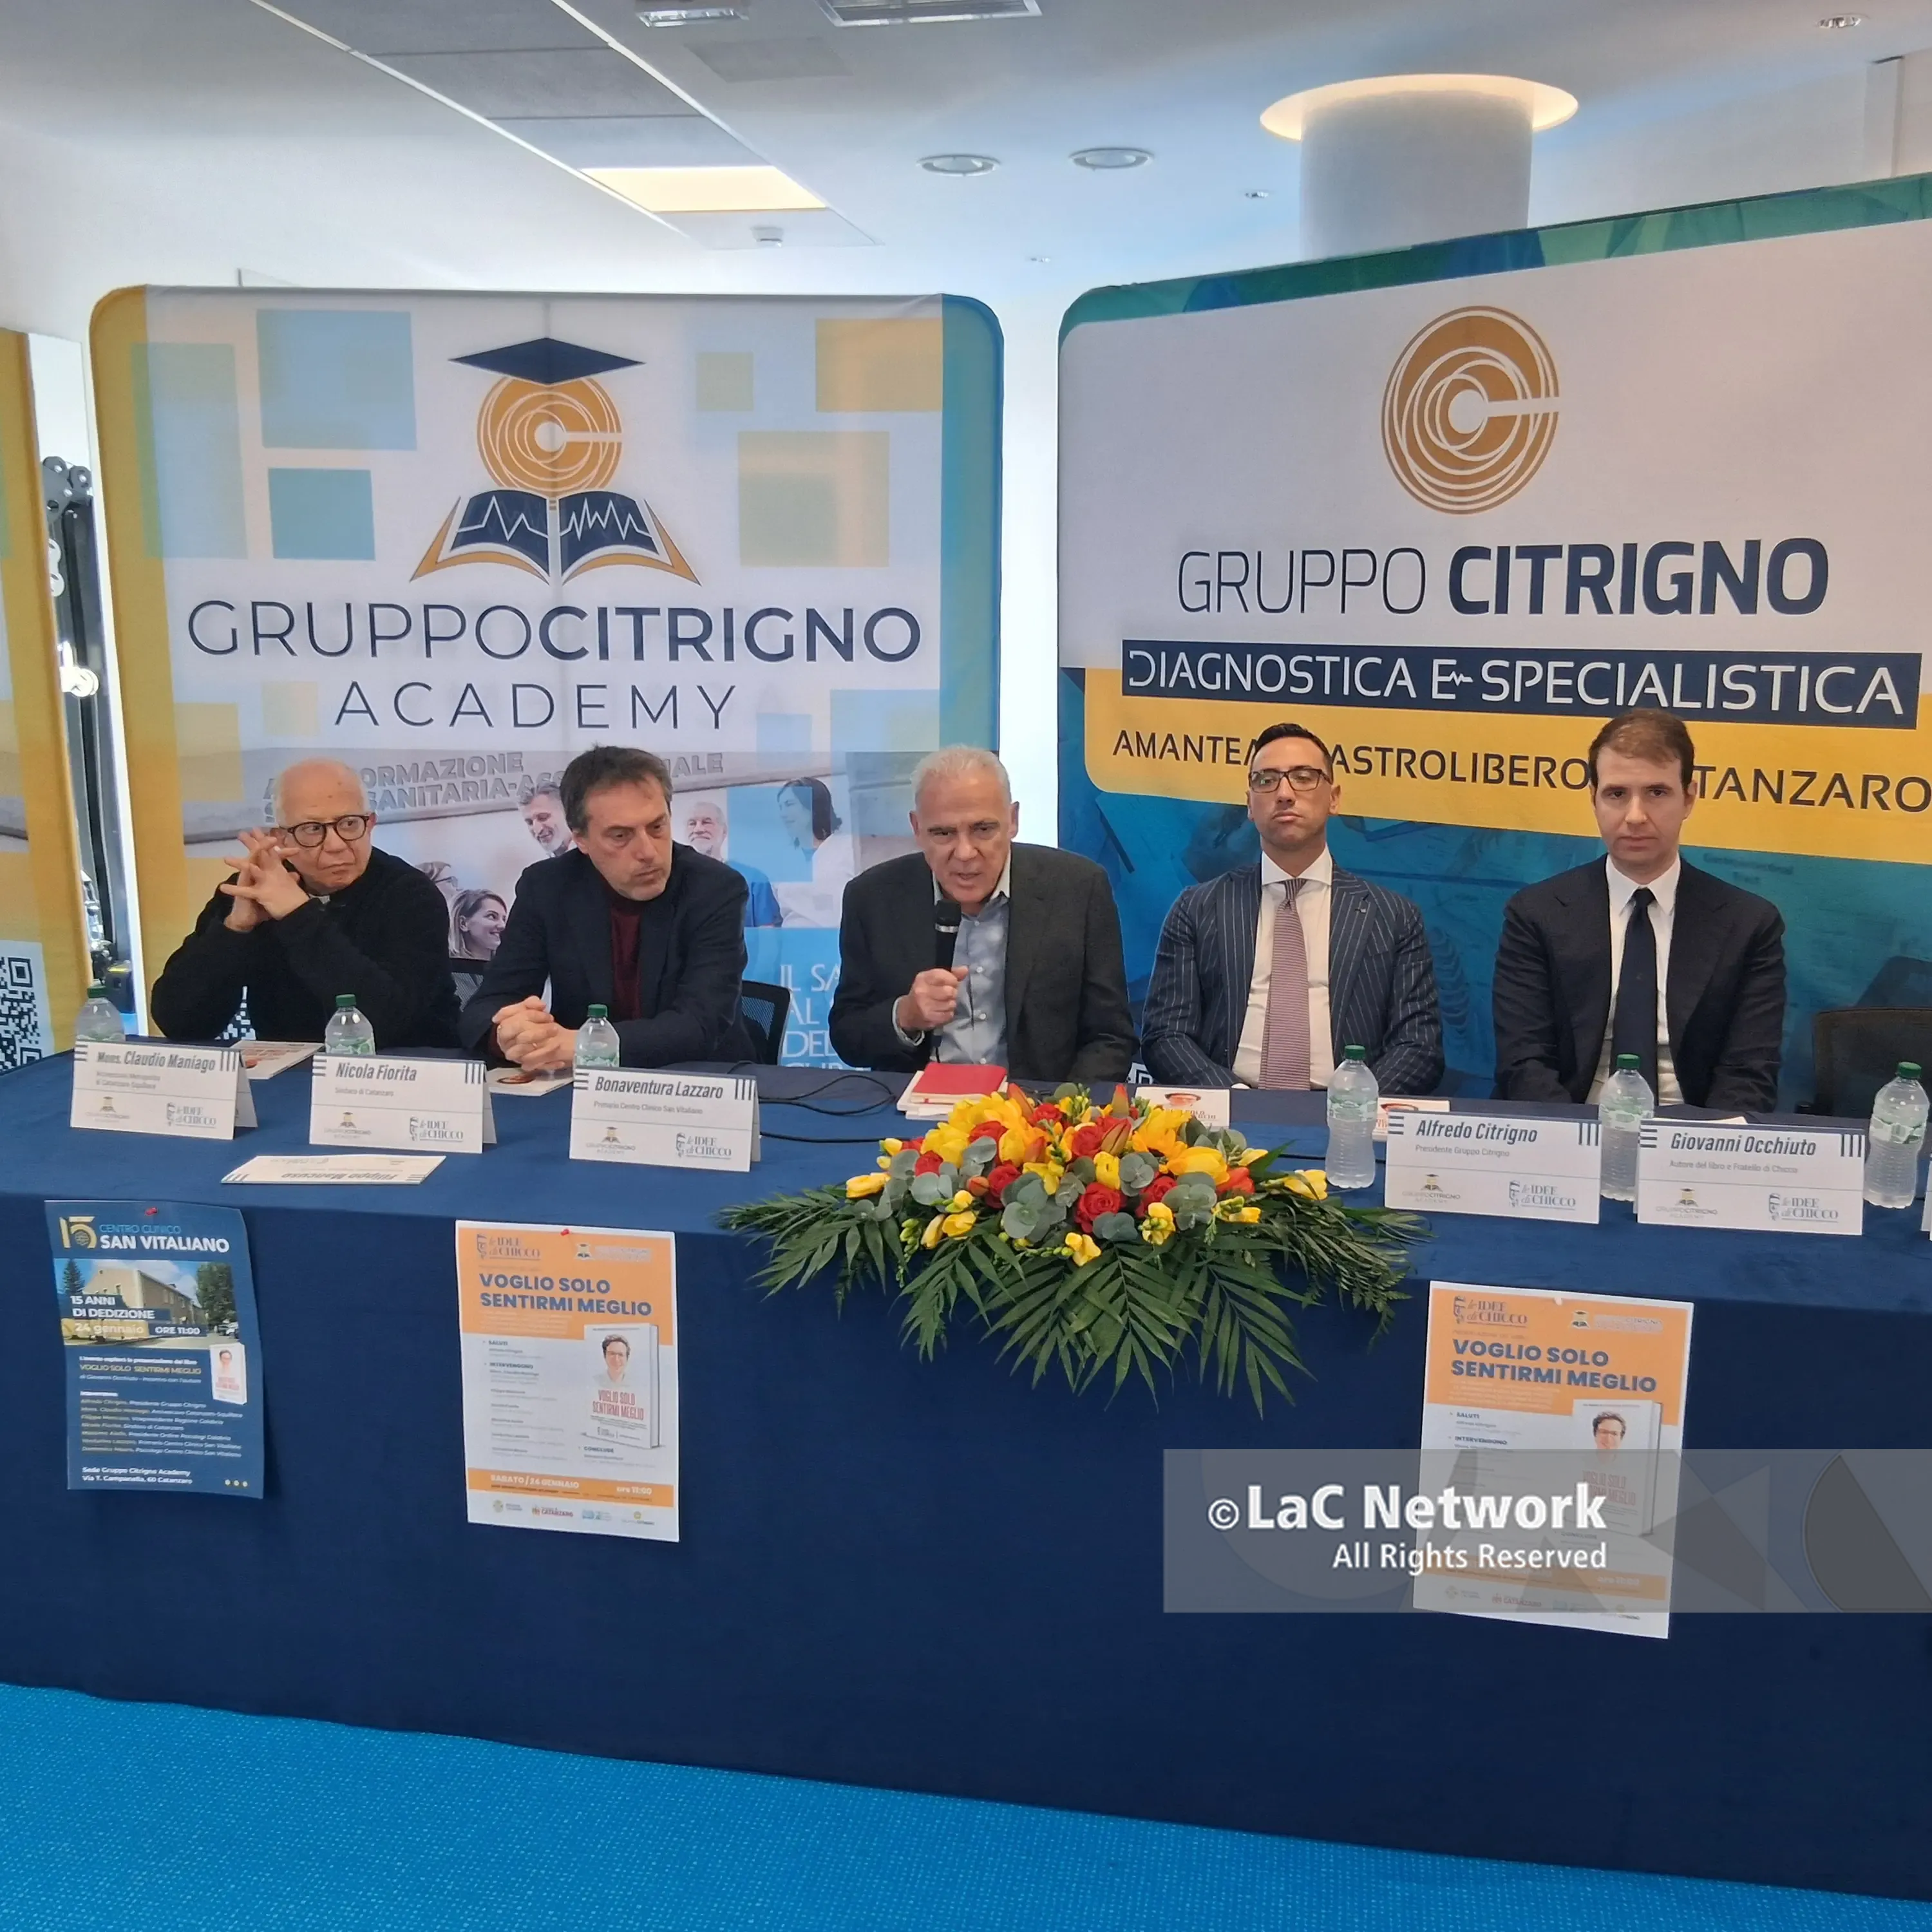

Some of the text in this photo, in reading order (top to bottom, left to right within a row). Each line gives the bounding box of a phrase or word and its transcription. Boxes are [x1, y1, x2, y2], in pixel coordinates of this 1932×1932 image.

[1178, 537, 1829, 616] GRUPPO CITRIGNO
[1128, 650, 1417, 699] DIAGNOSTICA
[1481, 659, 1904, 715] SPECIALISTICA
[334, 681, 736, 730] ACADEMY
[360, 752, 524, 789] ORMAZIONE
[1331, 744, 1591, 790] ASTROLIBERO
[1692, 764, 1931, 813] TANZARO
[124, 1051, 166, 1067] Claudio
[167, 1054, 216, 1073] Maniago
[336, 1062, 417, 1081] Nicola Fiorita
[595, 1076, 723, 1099] Bonaventura Lazzaro
[1416, 1119, 1538, 1144] Alfredo Citrigno
[1416, 1145, 1510, 1157] Presidente Gruppo Citrigno
[1671, 1132, 1817, 1156] Giovanni Occhiuto
[1670, 1160, 1694, 1170] Autore
[1695, 1161, 1707, 1170] del
[1709, 1162, 1725, 1170] libro
[1733, 1164, 1762, 1172] Fratello
[1532, 1195, 1576, 1208] CHICCO
[1792, 1209, 1839, 1220] CHICCO
[99, 1224, 182, 1235] CENTRO CLINICO
[100, 1235, 230, 1253] SAN VITALIANO
[479, 1273, 611, 1294] VOGLIO SOLO
[70, 1296, 115, 1305] 15 ANNI
[480, 1293, 652, 1316] SENTIRMI MEGLIO
[72, 1309, 155, 1319] DI DEDIZIONE
[75, 1323, 90, 1332] 24
[93, 1322, 144, 1336] gennaio
[1452, 1338, 1609, 1367] VOGLIO SOLO
[1451, 1359, 1657, 1393] SENTIRMI MEGLIO
[598, 1390, 636, 1405] VOGLIO SOLO
[592, 1401, 644, 1421] SENTIRMI MEGLIO
[158, 1468, 191, 1477] Academy
